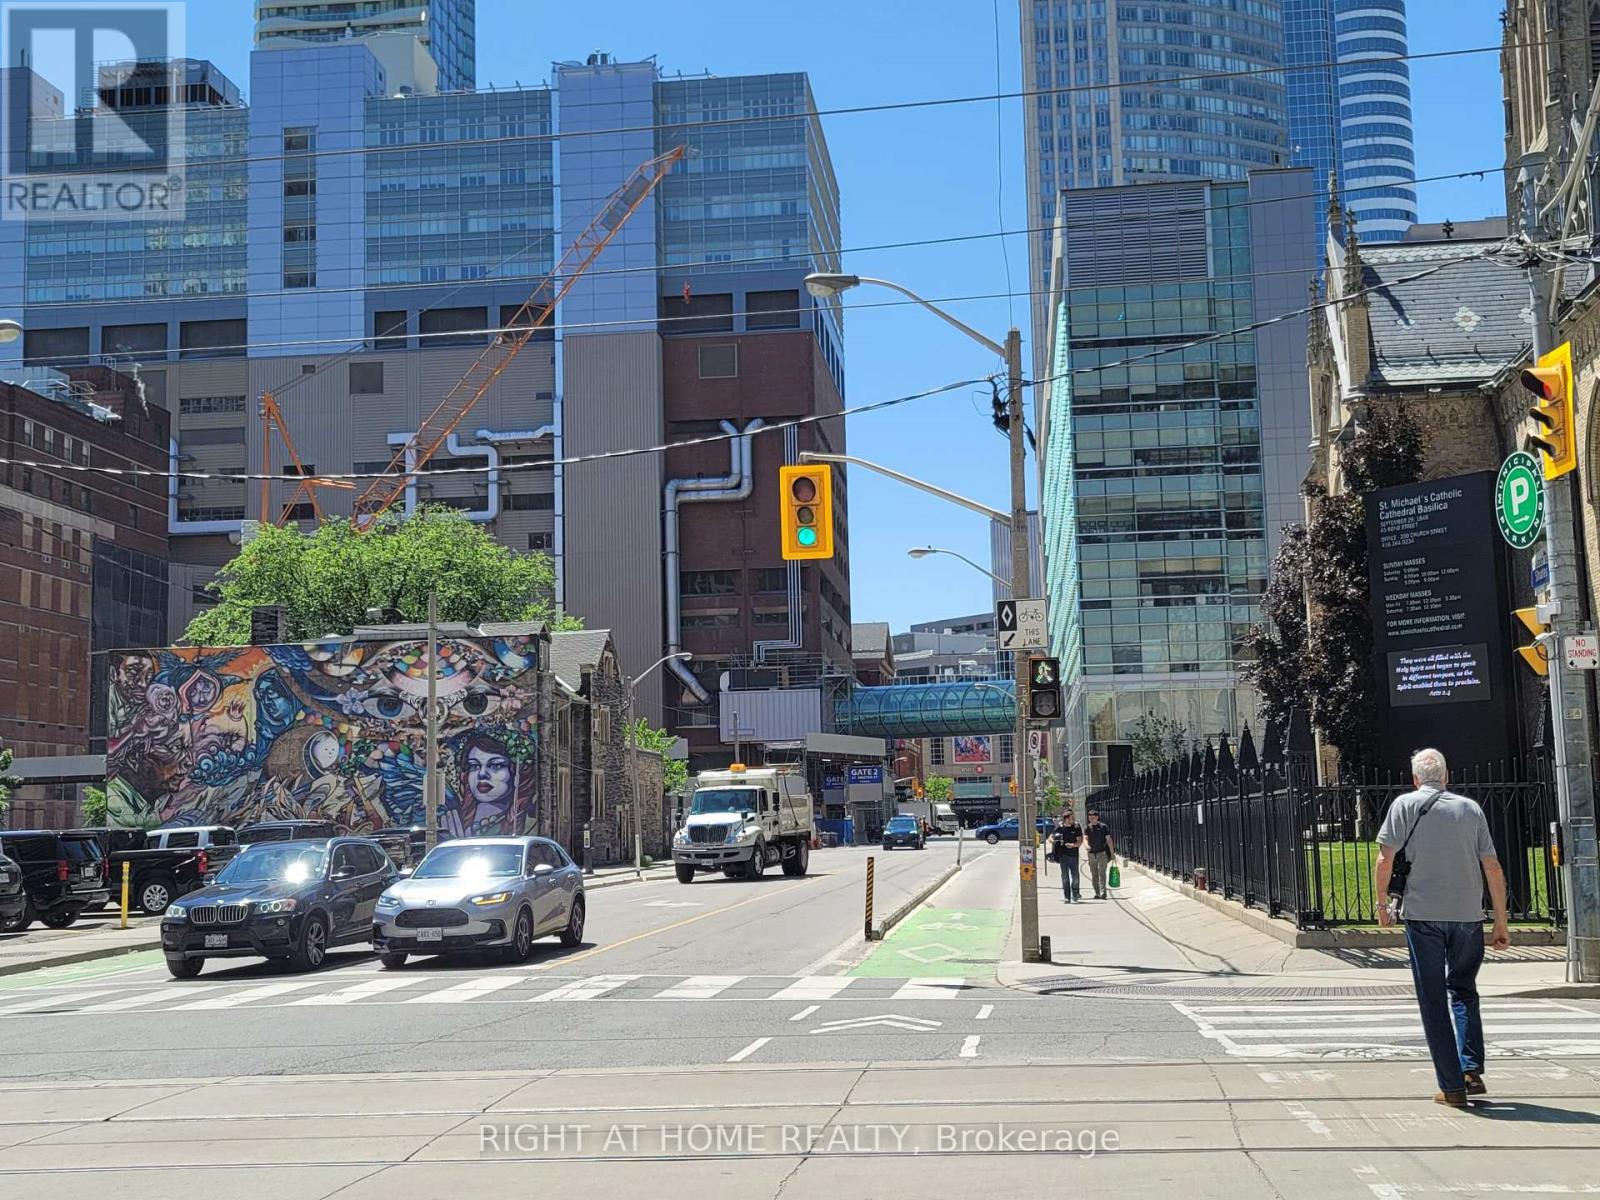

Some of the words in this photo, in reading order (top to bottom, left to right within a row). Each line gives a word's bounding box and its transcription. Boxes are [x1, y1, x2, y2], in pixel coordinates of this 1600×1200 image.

[1430, 489, 1463, 502] Catholic
[1510, 477, 1529, 516] P
[1380, 508, 1416, 520] Cathedral
[1404, 558, 1426, 566] MASSES
[1410, 590, 1432, 598] MASSES
[1025, 628, 1040, 636] THIS
[1023, 638, 1041, 646] LANE
[1575, 639, 1586, 648] NO
[1568, 649, 1596, 658] STANDING
[1409, 672, 1432, 682] different
[851, 768, 872, 776] GATE
[873, 768, 878, 776] 2
